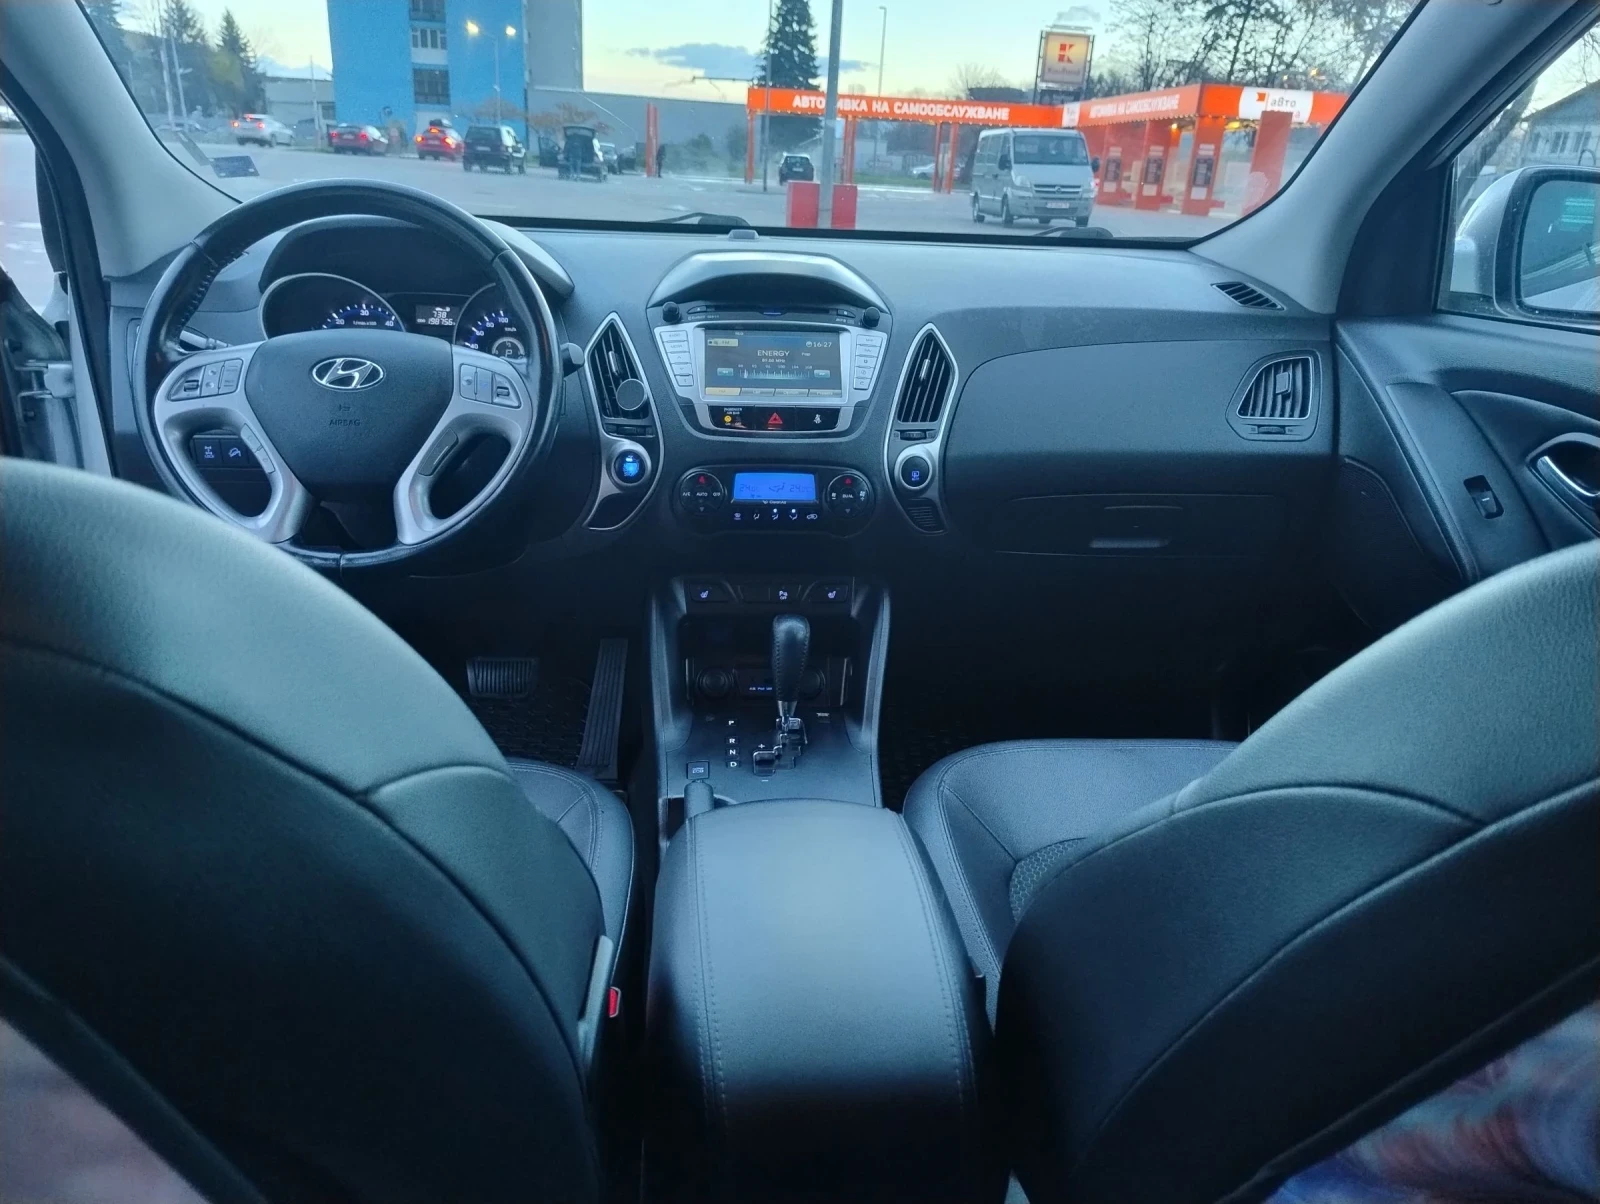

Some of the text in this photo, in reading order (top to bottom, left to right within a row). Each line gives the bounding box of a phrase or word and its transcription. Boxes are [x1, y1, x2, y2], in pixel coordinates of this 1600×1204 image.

[792, 95, 1010, 120] АВТОИВКА НА САМООБСЛУЖВАНЕ
[359, 309, 370, 317] 30
[432, 310, 447, 319] 738
